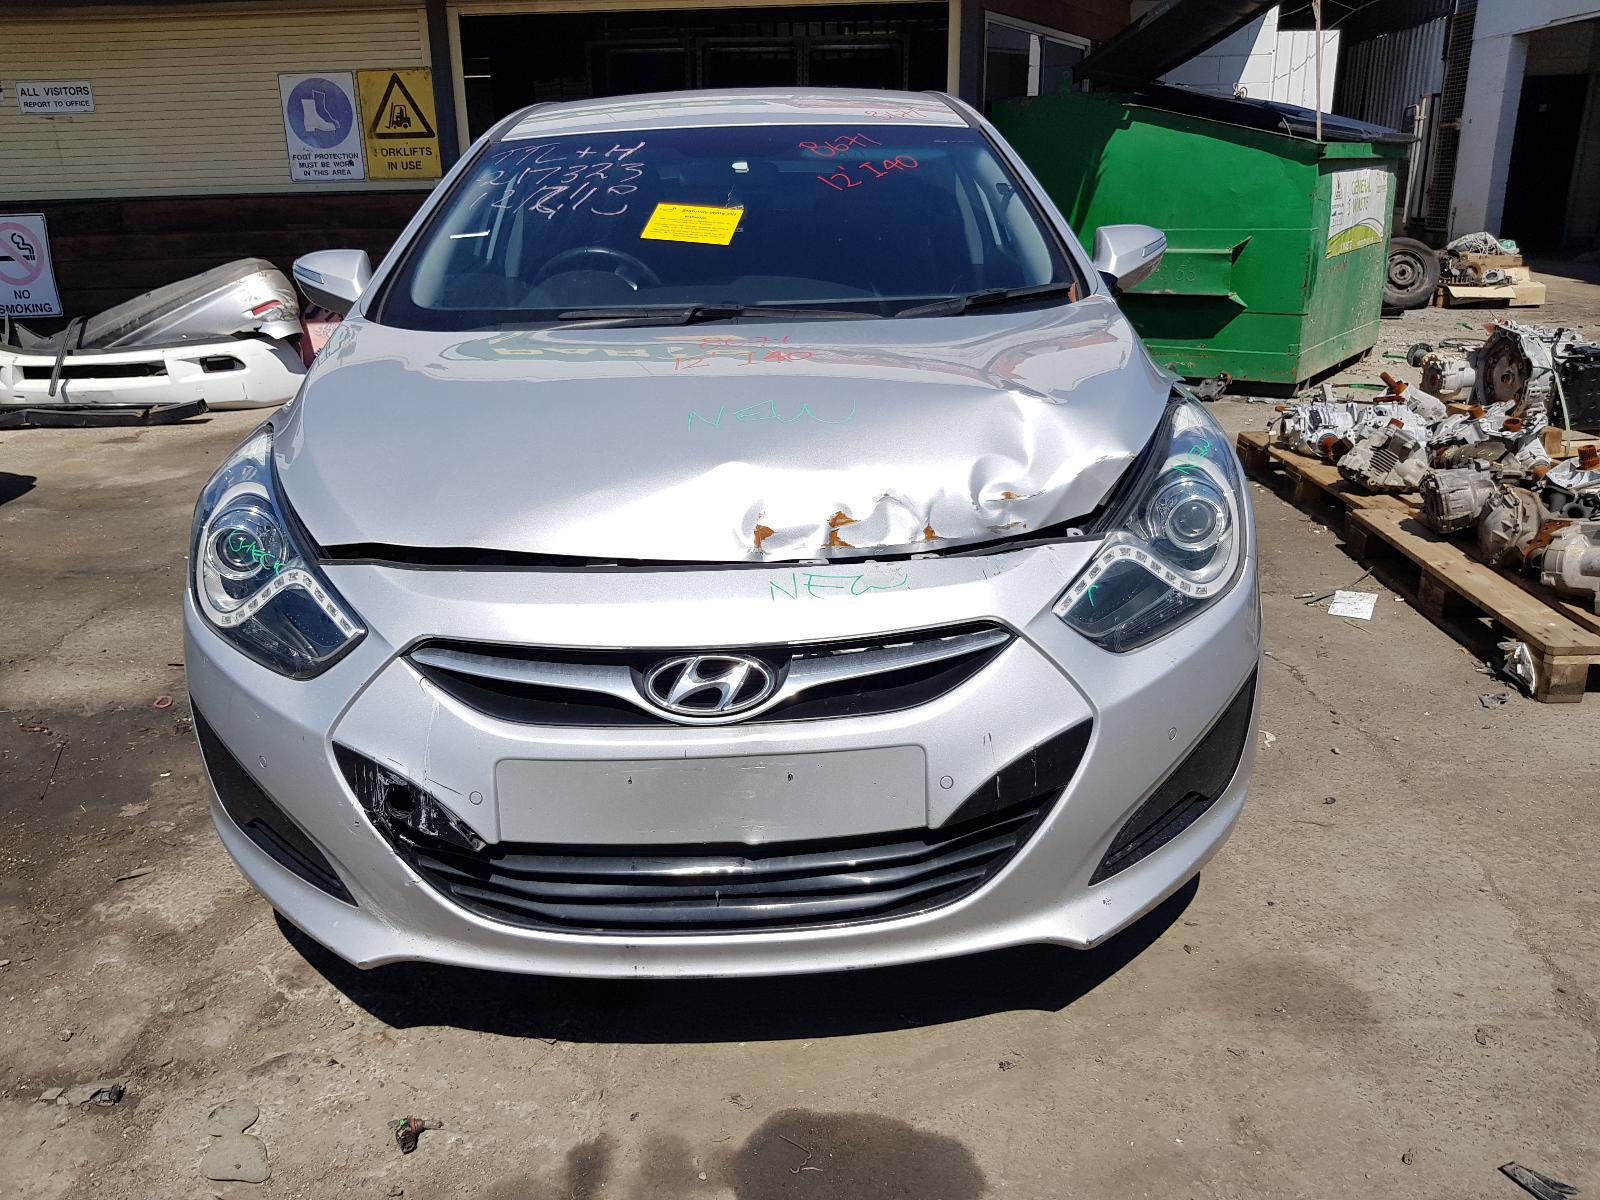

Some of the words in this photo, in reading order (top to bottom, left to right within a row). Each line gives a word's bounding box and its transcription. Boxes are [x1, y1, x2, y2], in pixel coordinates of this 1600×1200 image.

[20, 87, 40, 97] ALL
[43, 86, 90, 96] VISITORS
[292, 153, 312, 161] FOOT
[314, 152, 359, 160] PROTECTION
[604, 141, 646, 161] H
[387, 161, 400, 171] IN
[402, 160, 423, 170] USE
[13, 289, 31, 300] NO
[0, 303, 53, 314] SMOKING
[687, 399, 856, 433] NEW
[769, 572, 908, 601] NEW
